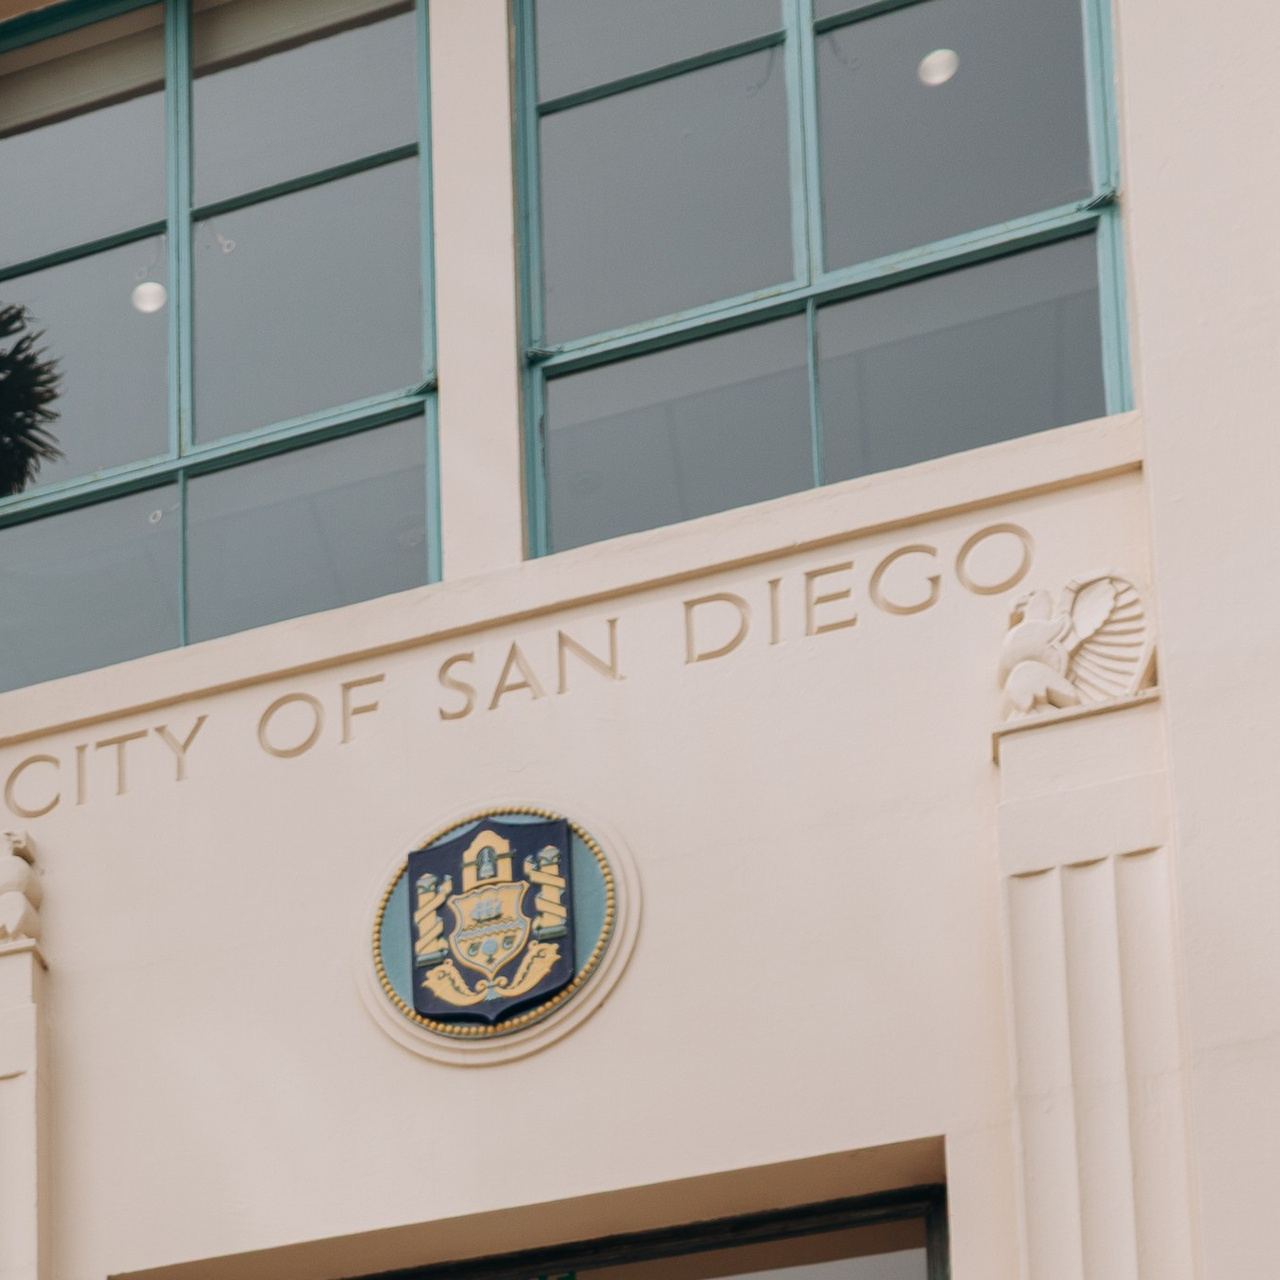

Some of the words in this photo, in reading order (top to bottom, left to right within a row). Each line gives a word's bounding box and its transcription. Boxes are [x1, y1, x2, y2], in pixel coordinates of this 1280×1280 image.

[4, 714, 209, 818] CITY
[258, 673, 386, 758] OF
[438, 617, 626, 721] SAN
[682, 523, 1036, 664] DIEGO
